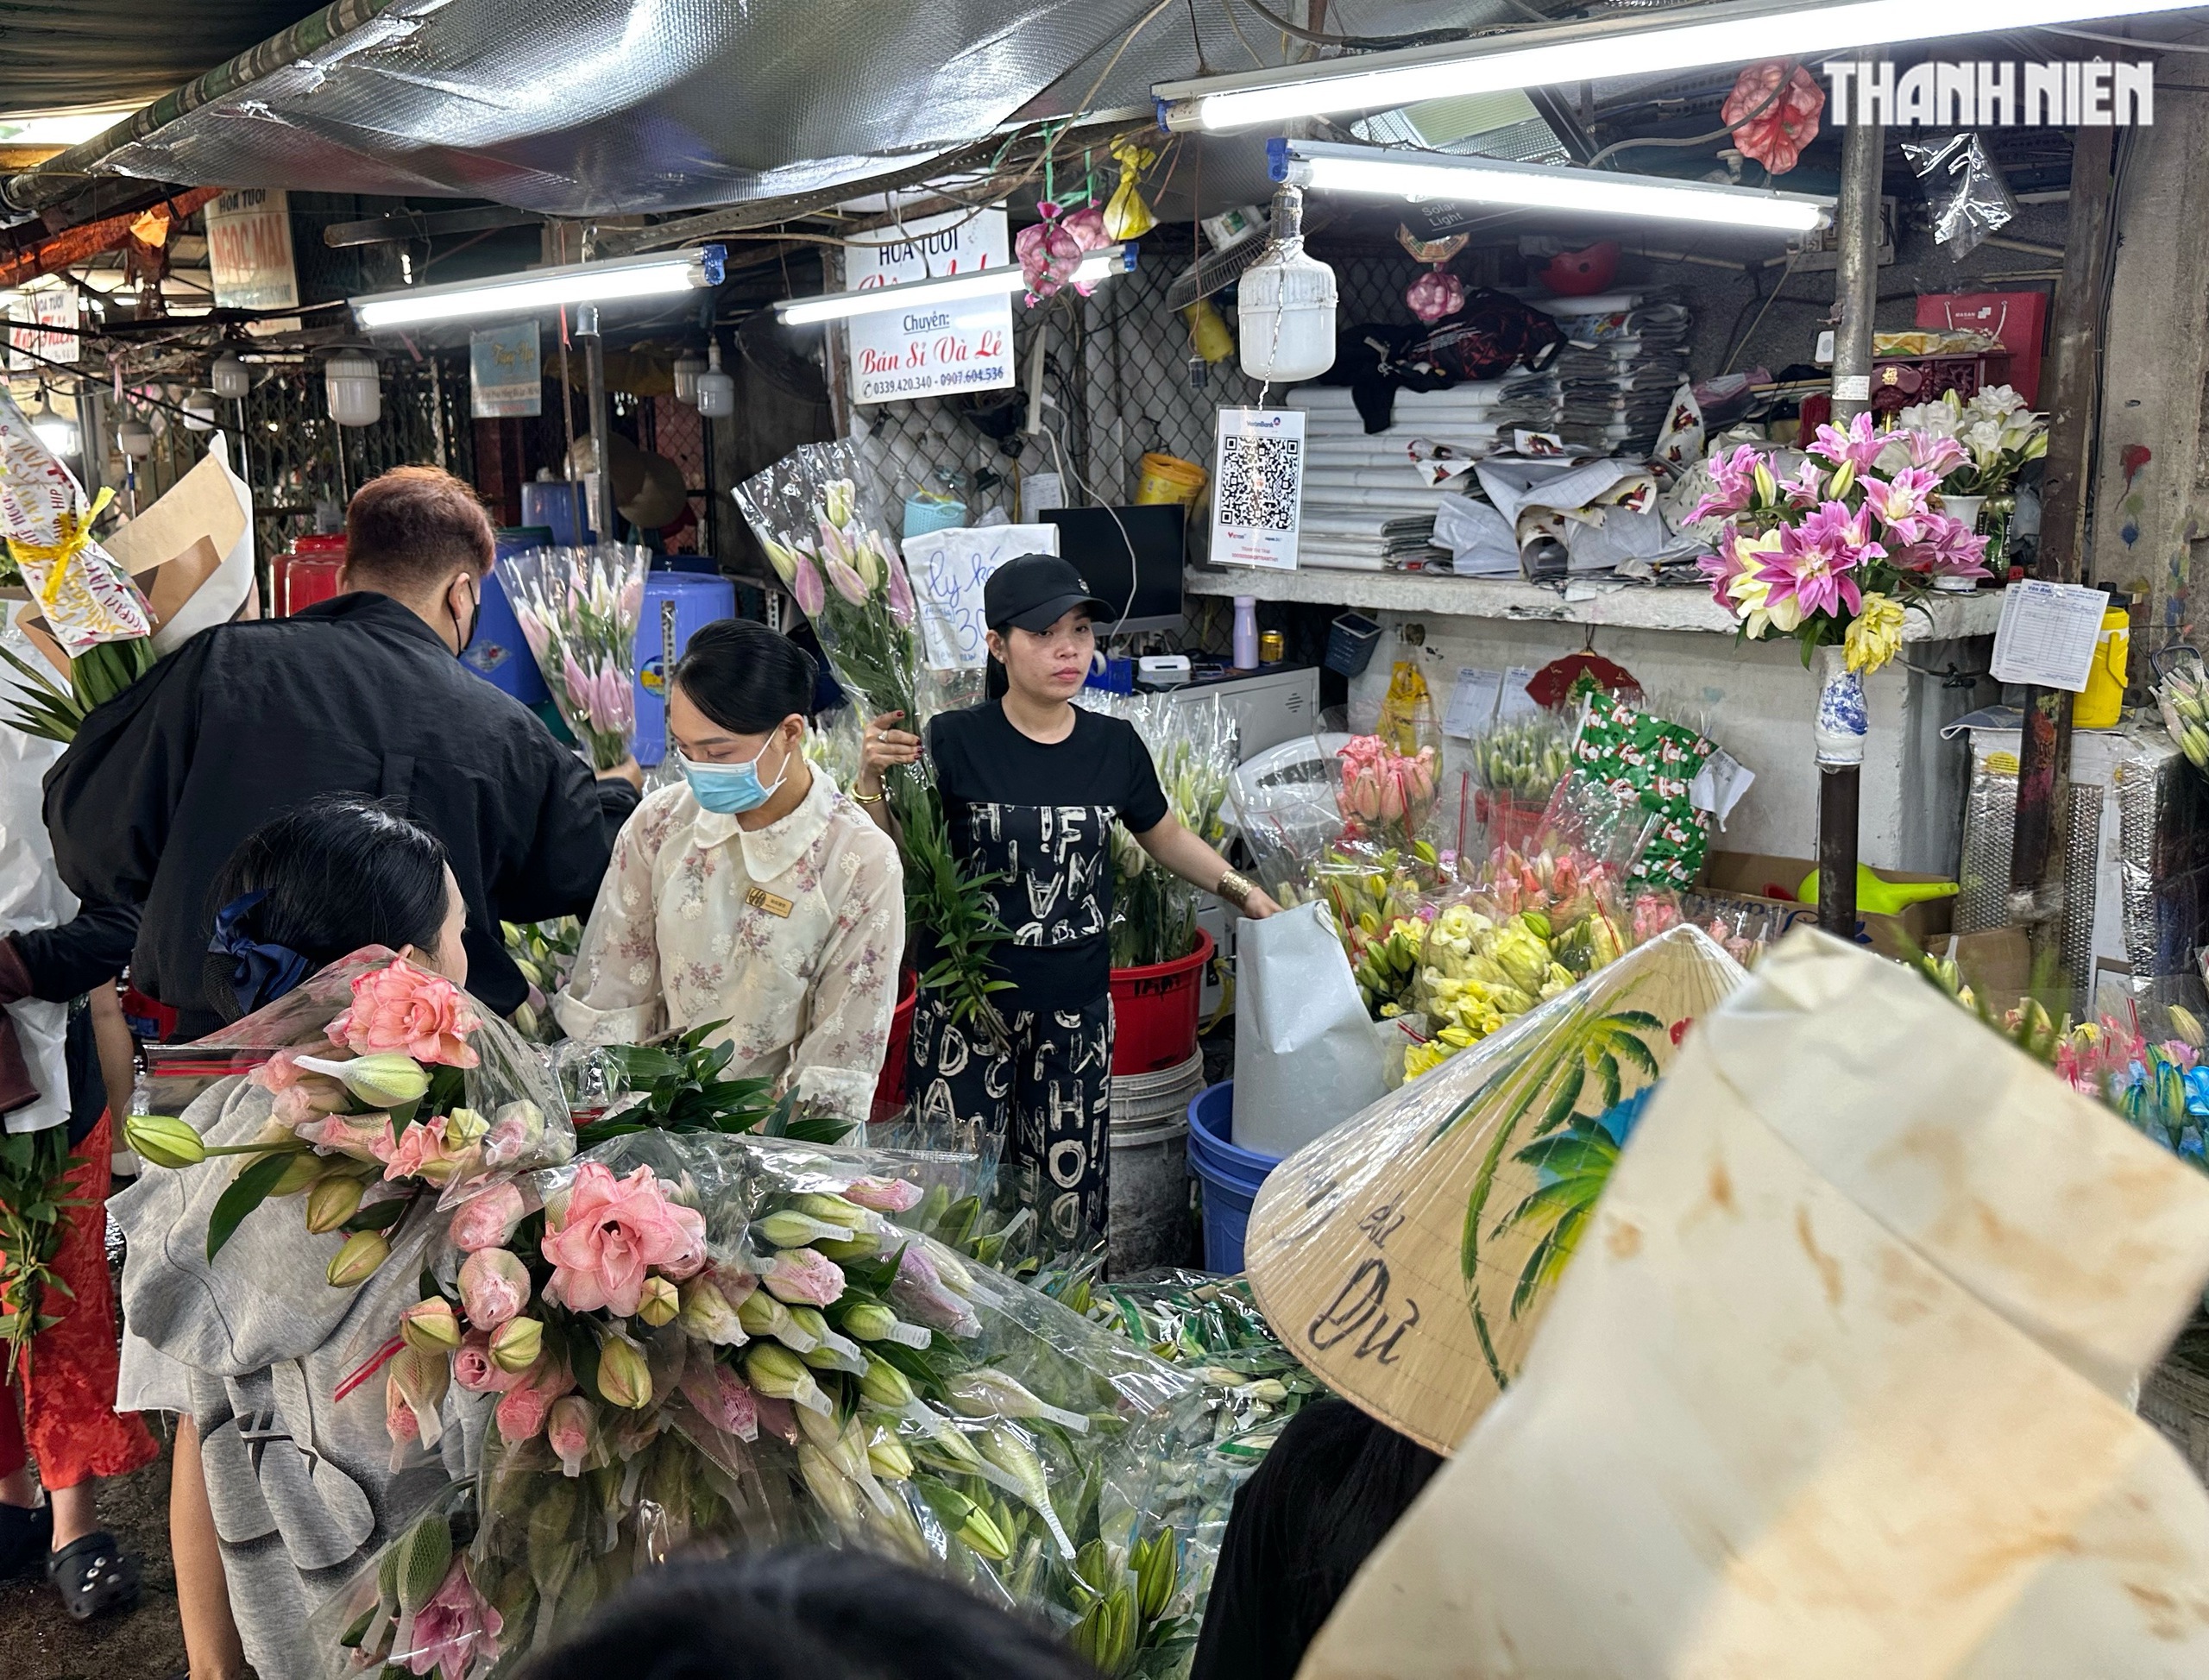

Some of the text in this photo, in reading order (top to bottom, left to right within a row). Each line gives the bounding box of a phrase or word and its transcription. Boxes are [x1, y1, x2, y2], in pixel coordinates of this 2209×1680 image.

[1421, 203, 1457, 217] Solar
[1428, 211, 1464, 227] Light
[879, 242, 915, 266] HOA
[859, 348, 901, 375] Bán
[933, 336, 968, 364] Và
